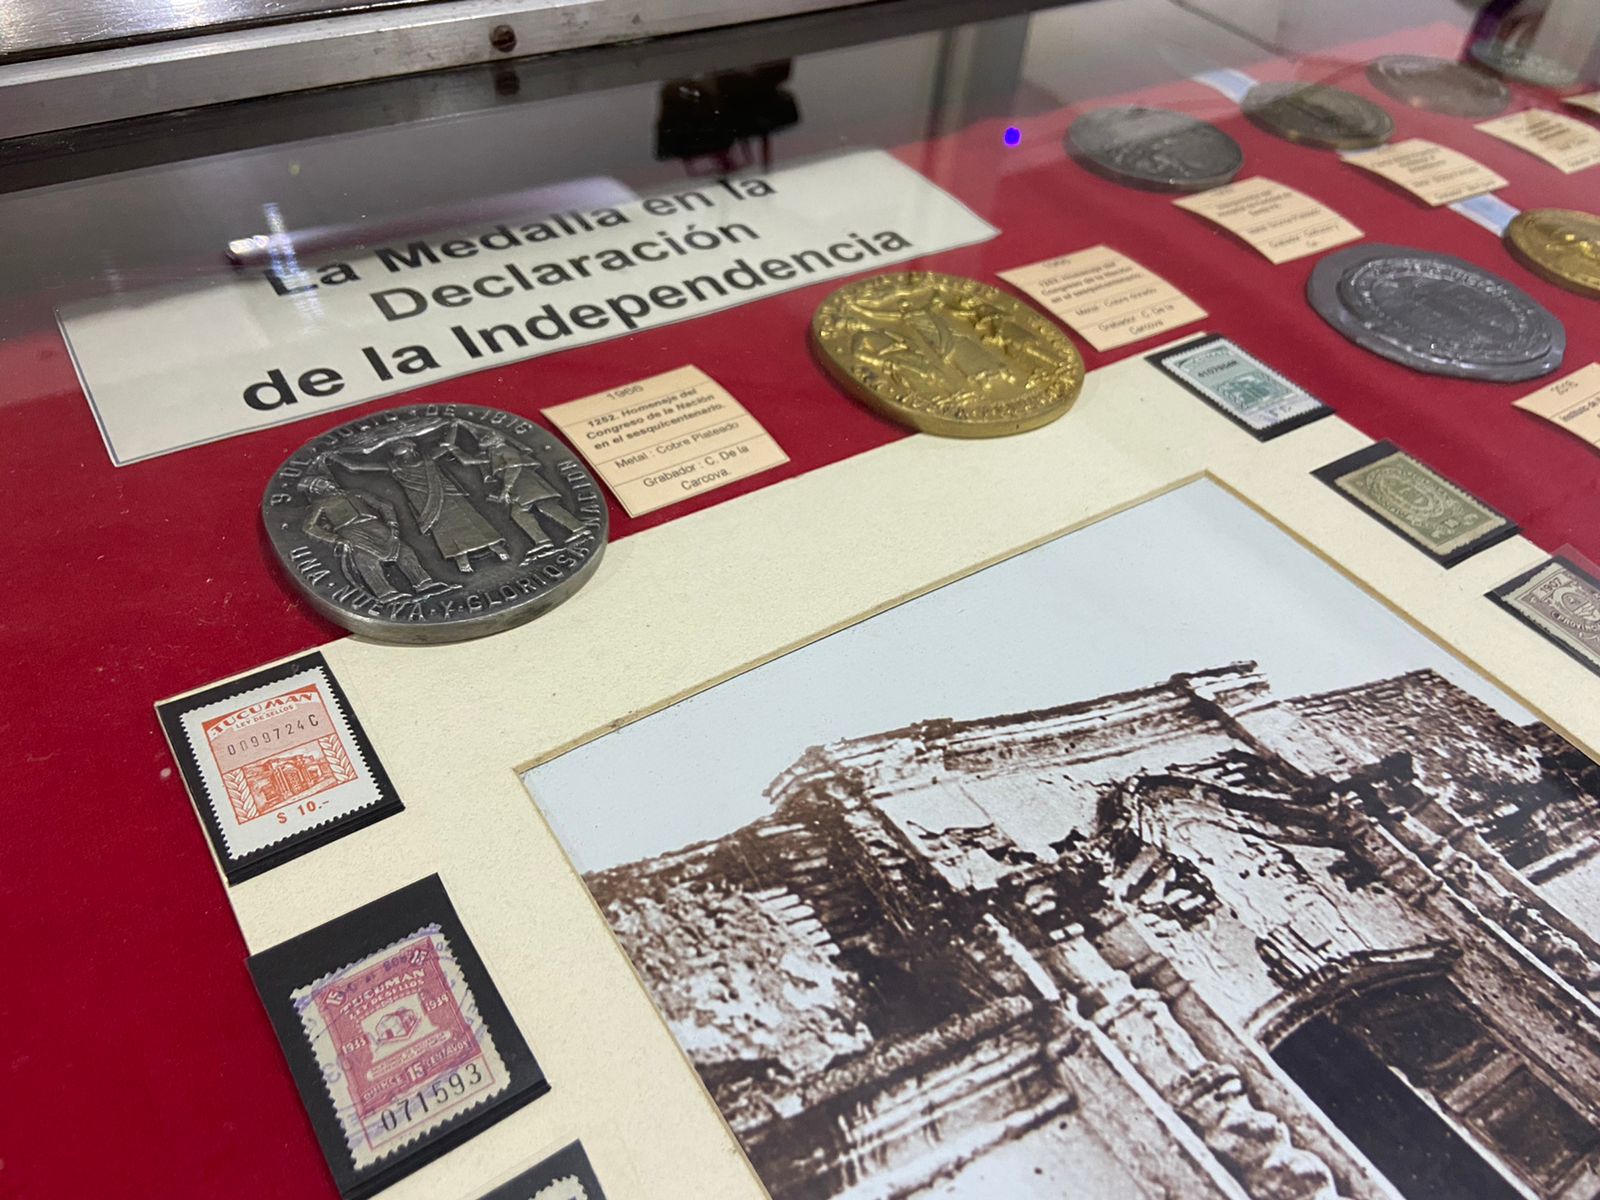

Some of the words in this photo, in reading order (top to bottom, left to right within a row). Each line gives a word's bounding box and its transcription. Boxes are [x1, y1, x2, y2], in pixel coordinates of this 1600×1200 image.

[266, 262, 360, 296] La
[375, 203, 631, 272] Medalla
[642, 184, 716, 217] en
[717, 173, 777, 200] la
[370, 222, 760, 321] Declaración
[243, 367, 346, 411] de
[362, 341, 439, 381] la
[451, 229, 913, 359] Independencia
[586, 417, 645, 440] Congreso
[647, 411, 662, 421] de
[663, 407, 674, 415] la
[676, 394, 715, 411] Nación
[621, 395, 678, 417] Homenaje
[680, 388, 697, 399] del
[594, 441, 610, 450] en
[612, 435, 624, 443] el
[614, 452, 648, 469] Metal
[656, 438, 691, 454] Cobre
[692, 422, 740, 442] Plateado
[643, 463, 697, 488] Grabador
[719, 450, 737, 461] De
[737, 445, 749, 453] la
[235, 719, 252, 729] LEY
[254, 714, 265, 723] DE
[266, 704, 294, 718] SELLOS
[406, 1062, 426, 1082] 15
[380, 1063, 483, 1132] 071593
